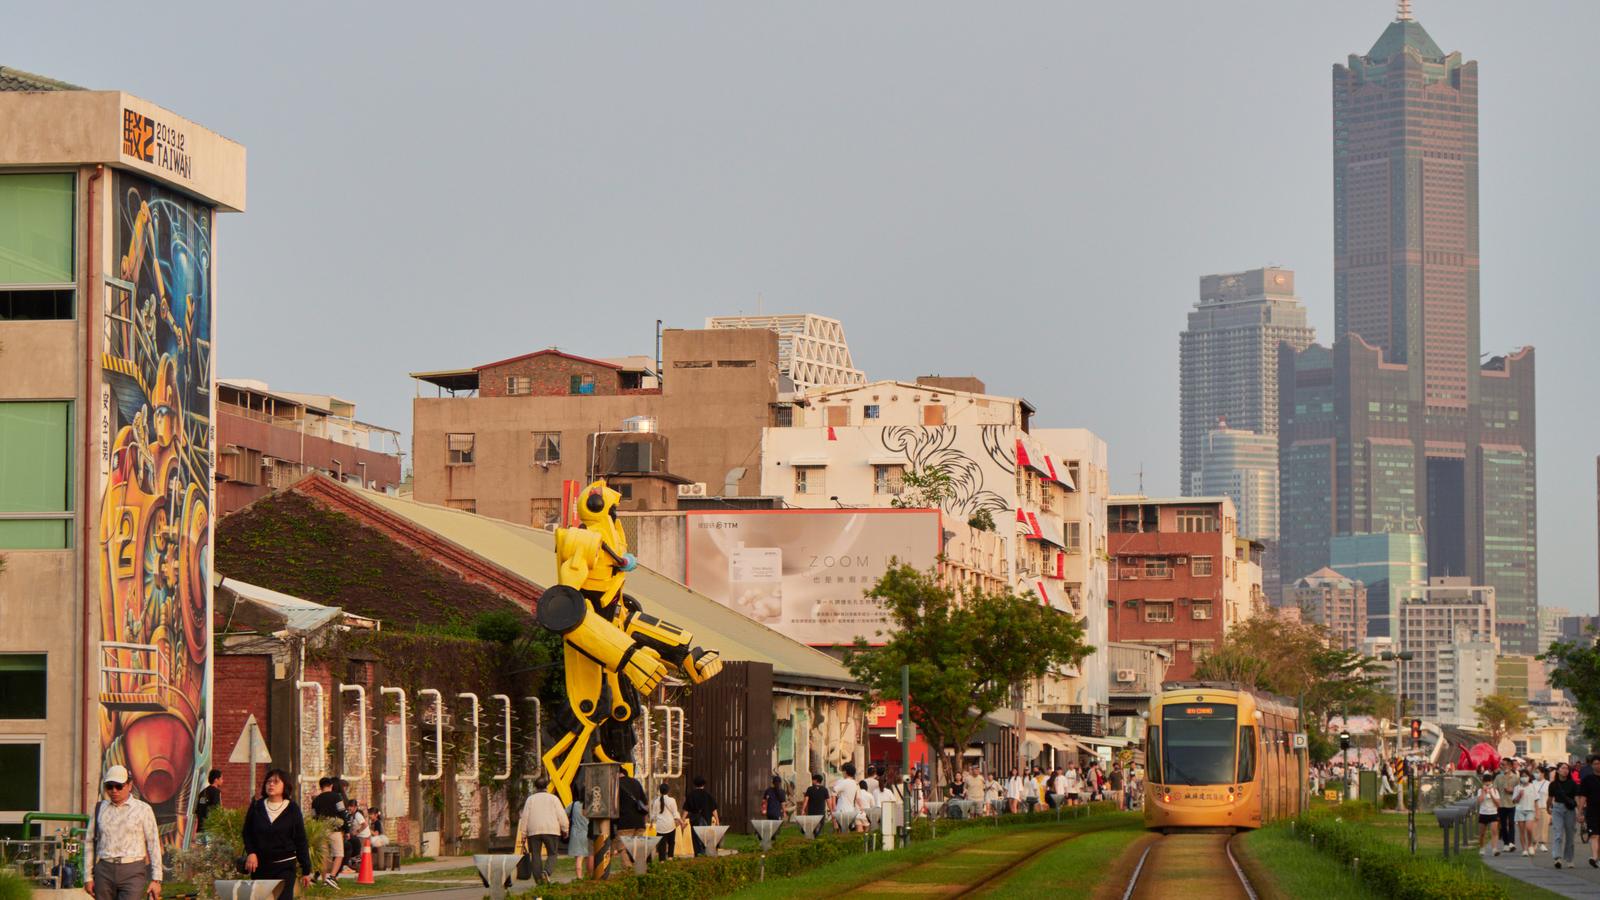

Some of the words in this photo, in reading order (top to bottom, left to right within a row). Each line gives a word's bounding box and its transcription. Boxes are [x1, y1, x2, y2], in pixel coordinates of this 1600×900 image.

[157, 142, 192, 180] TAIWAN
[724, 521, 739, 529] TTM
[118, 510, 134, 568] 2
[809, 555, 869, 568] ZOOM
[1296, 736, 1305, 746] D
